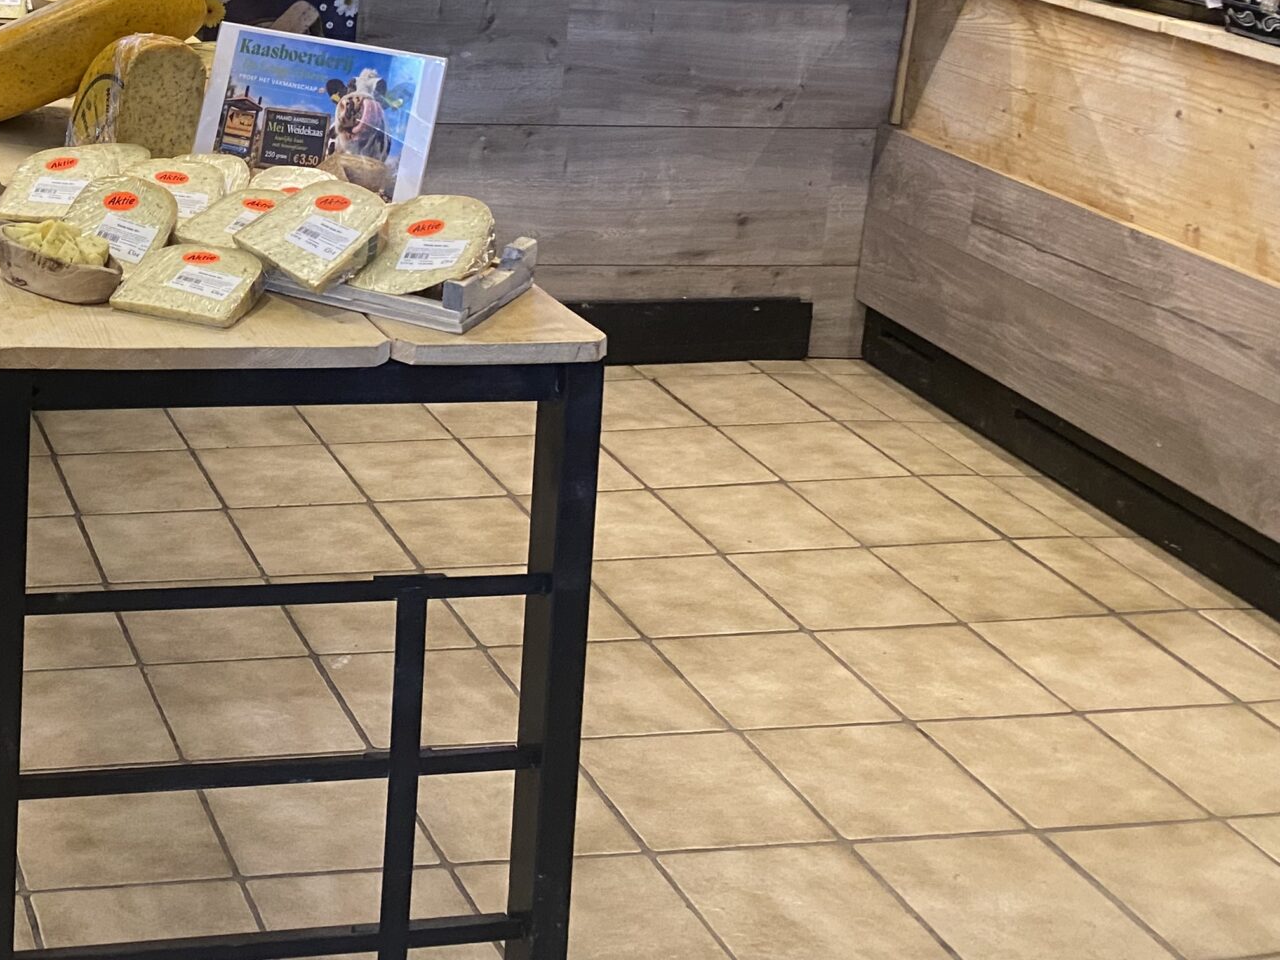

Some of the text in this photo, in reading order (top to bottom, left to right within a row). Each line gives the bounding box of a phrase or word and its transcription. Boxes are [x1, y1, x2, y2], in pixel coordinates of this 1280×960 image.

[272, 78, 318, 91] VAKMANSCHAP
[267, 121, 323, 138] Mei Weidekaas
[265, 150, 276, 158] 250
[50, 158, 75, 169] Aktie
[159, 173, 186, 182] Aktie
[107, 195, 135, 206] Aktie
[413, 223, 441, 233] Aktie
